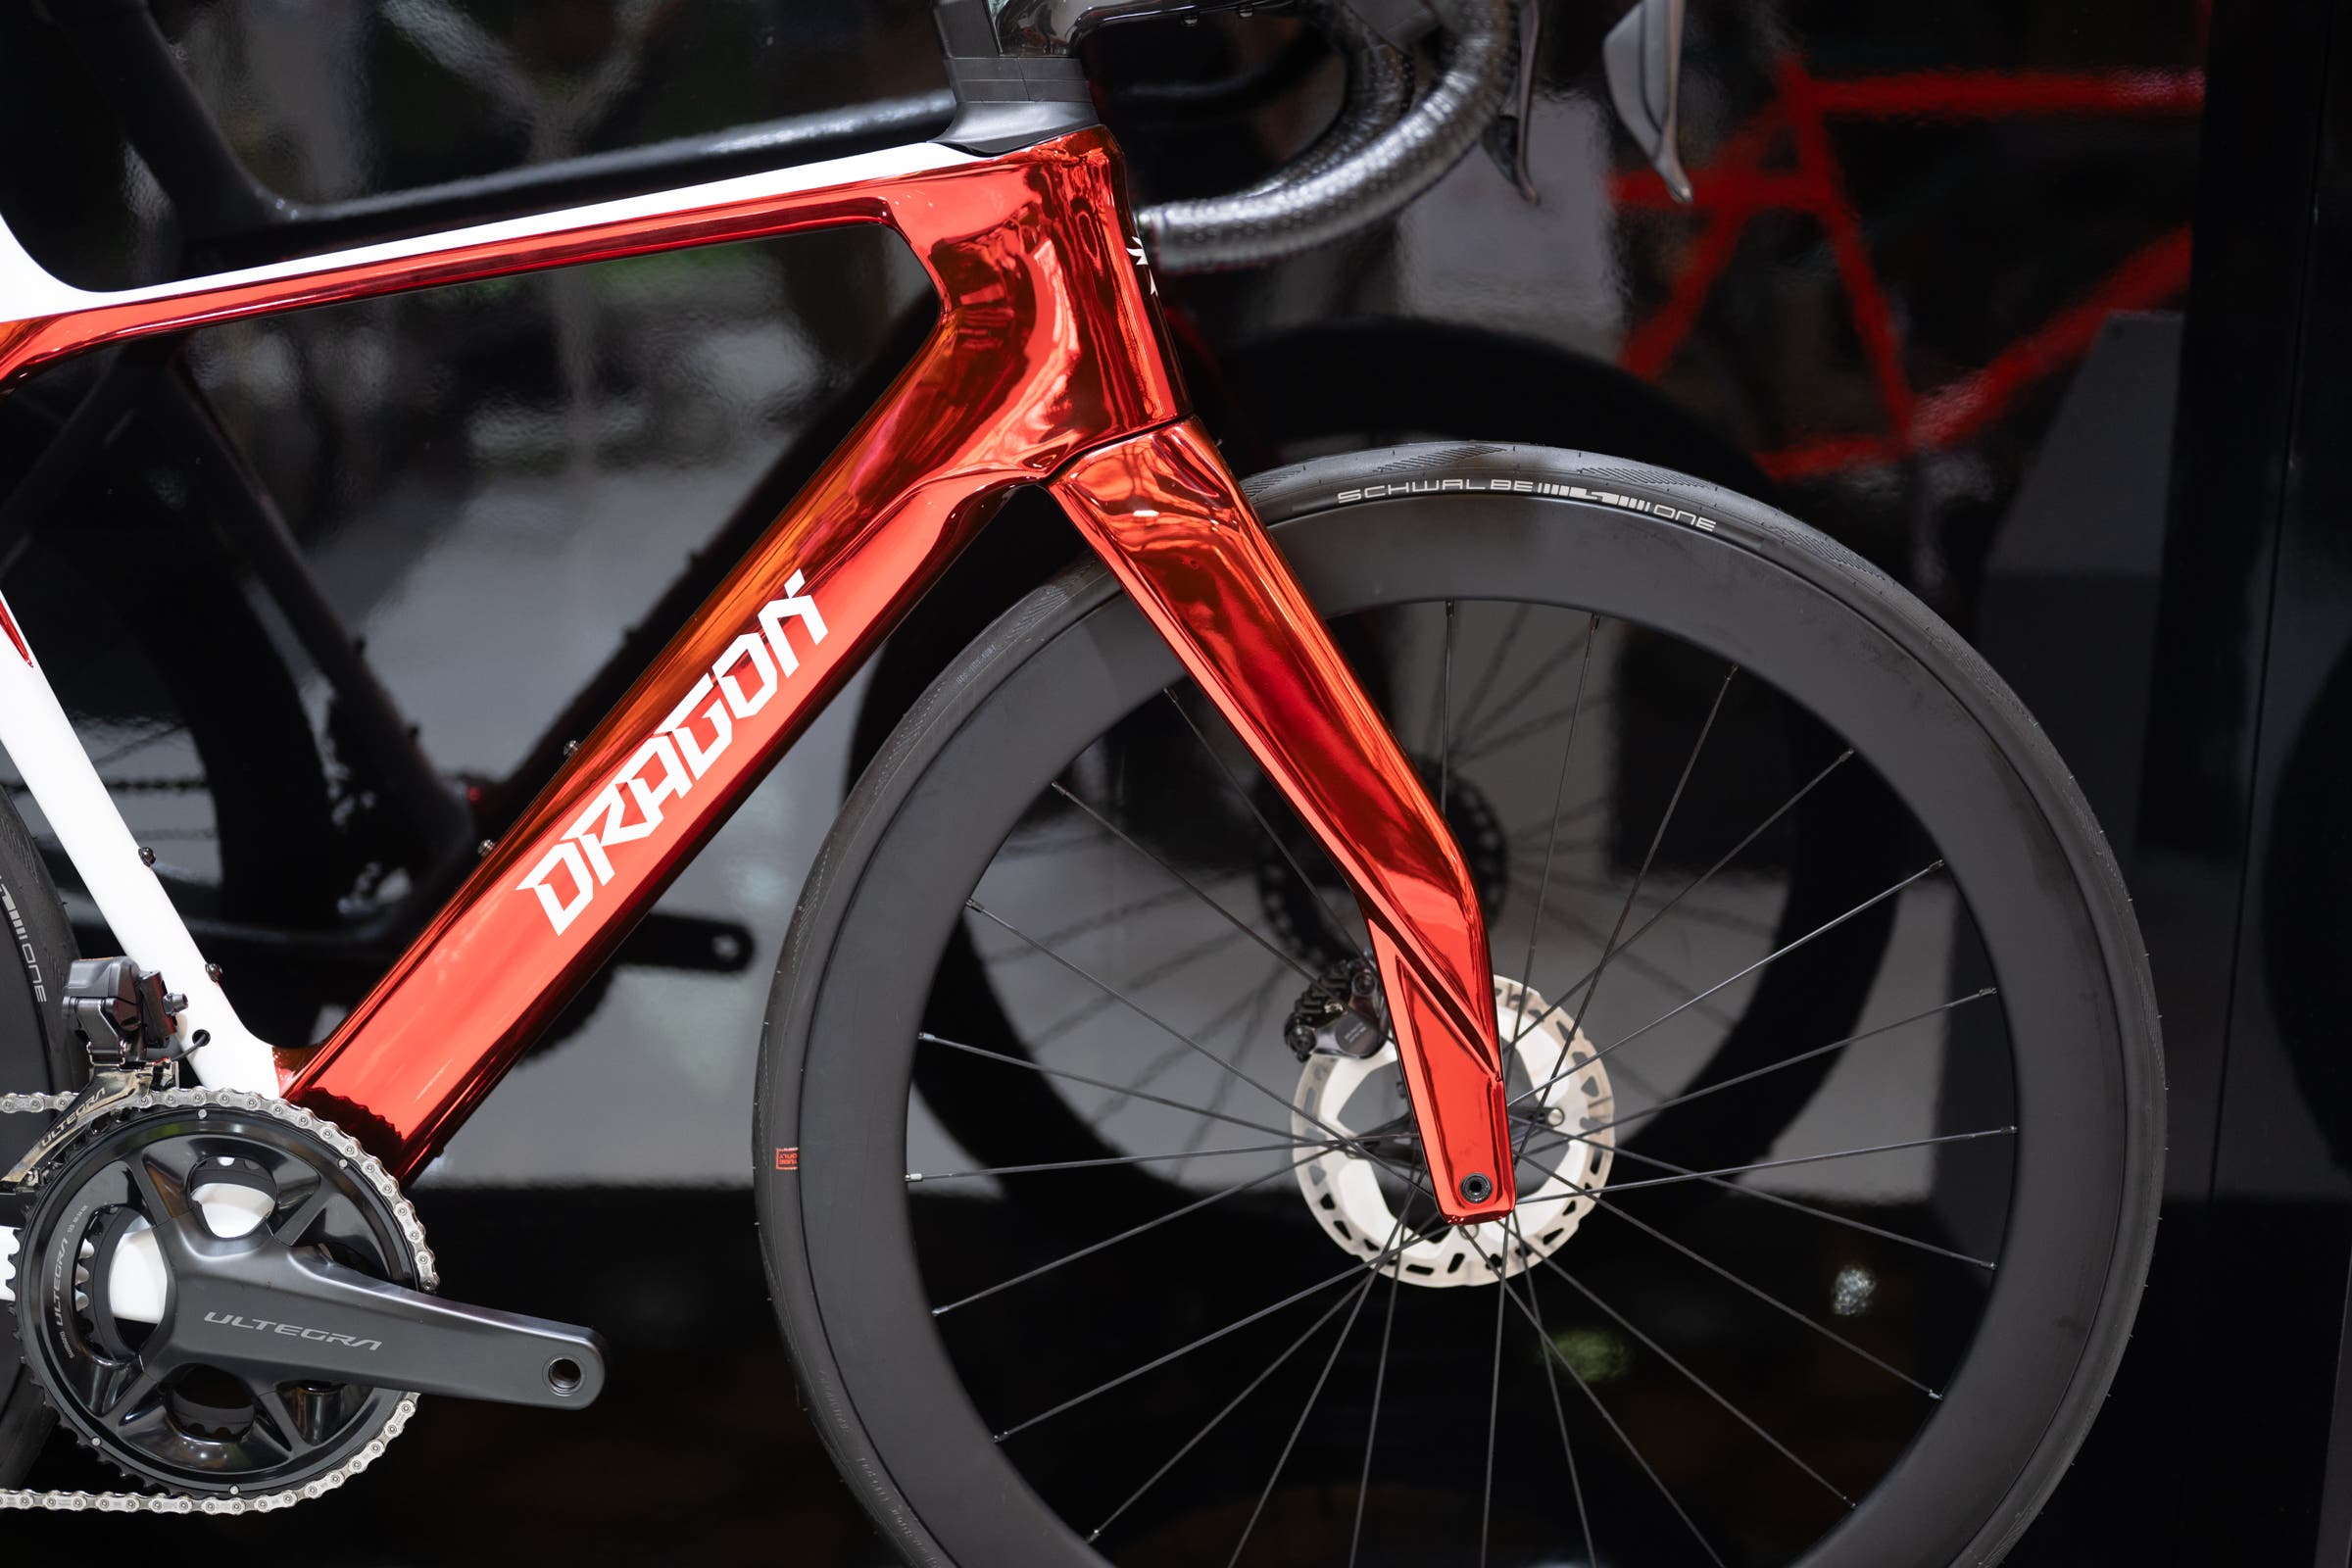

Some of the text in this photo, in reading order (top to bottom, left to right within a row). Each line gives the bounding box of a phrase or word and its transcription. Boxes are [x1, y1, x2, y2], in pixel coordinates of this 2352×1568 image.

[1337, 478, 1717, 533] SCHWALBE ONE
[515, 567, 829, 936] DRAGON
[22, 943, 47, 1003] ONE
[41, 1087, 106, 1147] ULTEGRA
[53, 1237, 69, 1326] ULTEGRA
[203, 1311, 383, 1351] ULTEGRA
